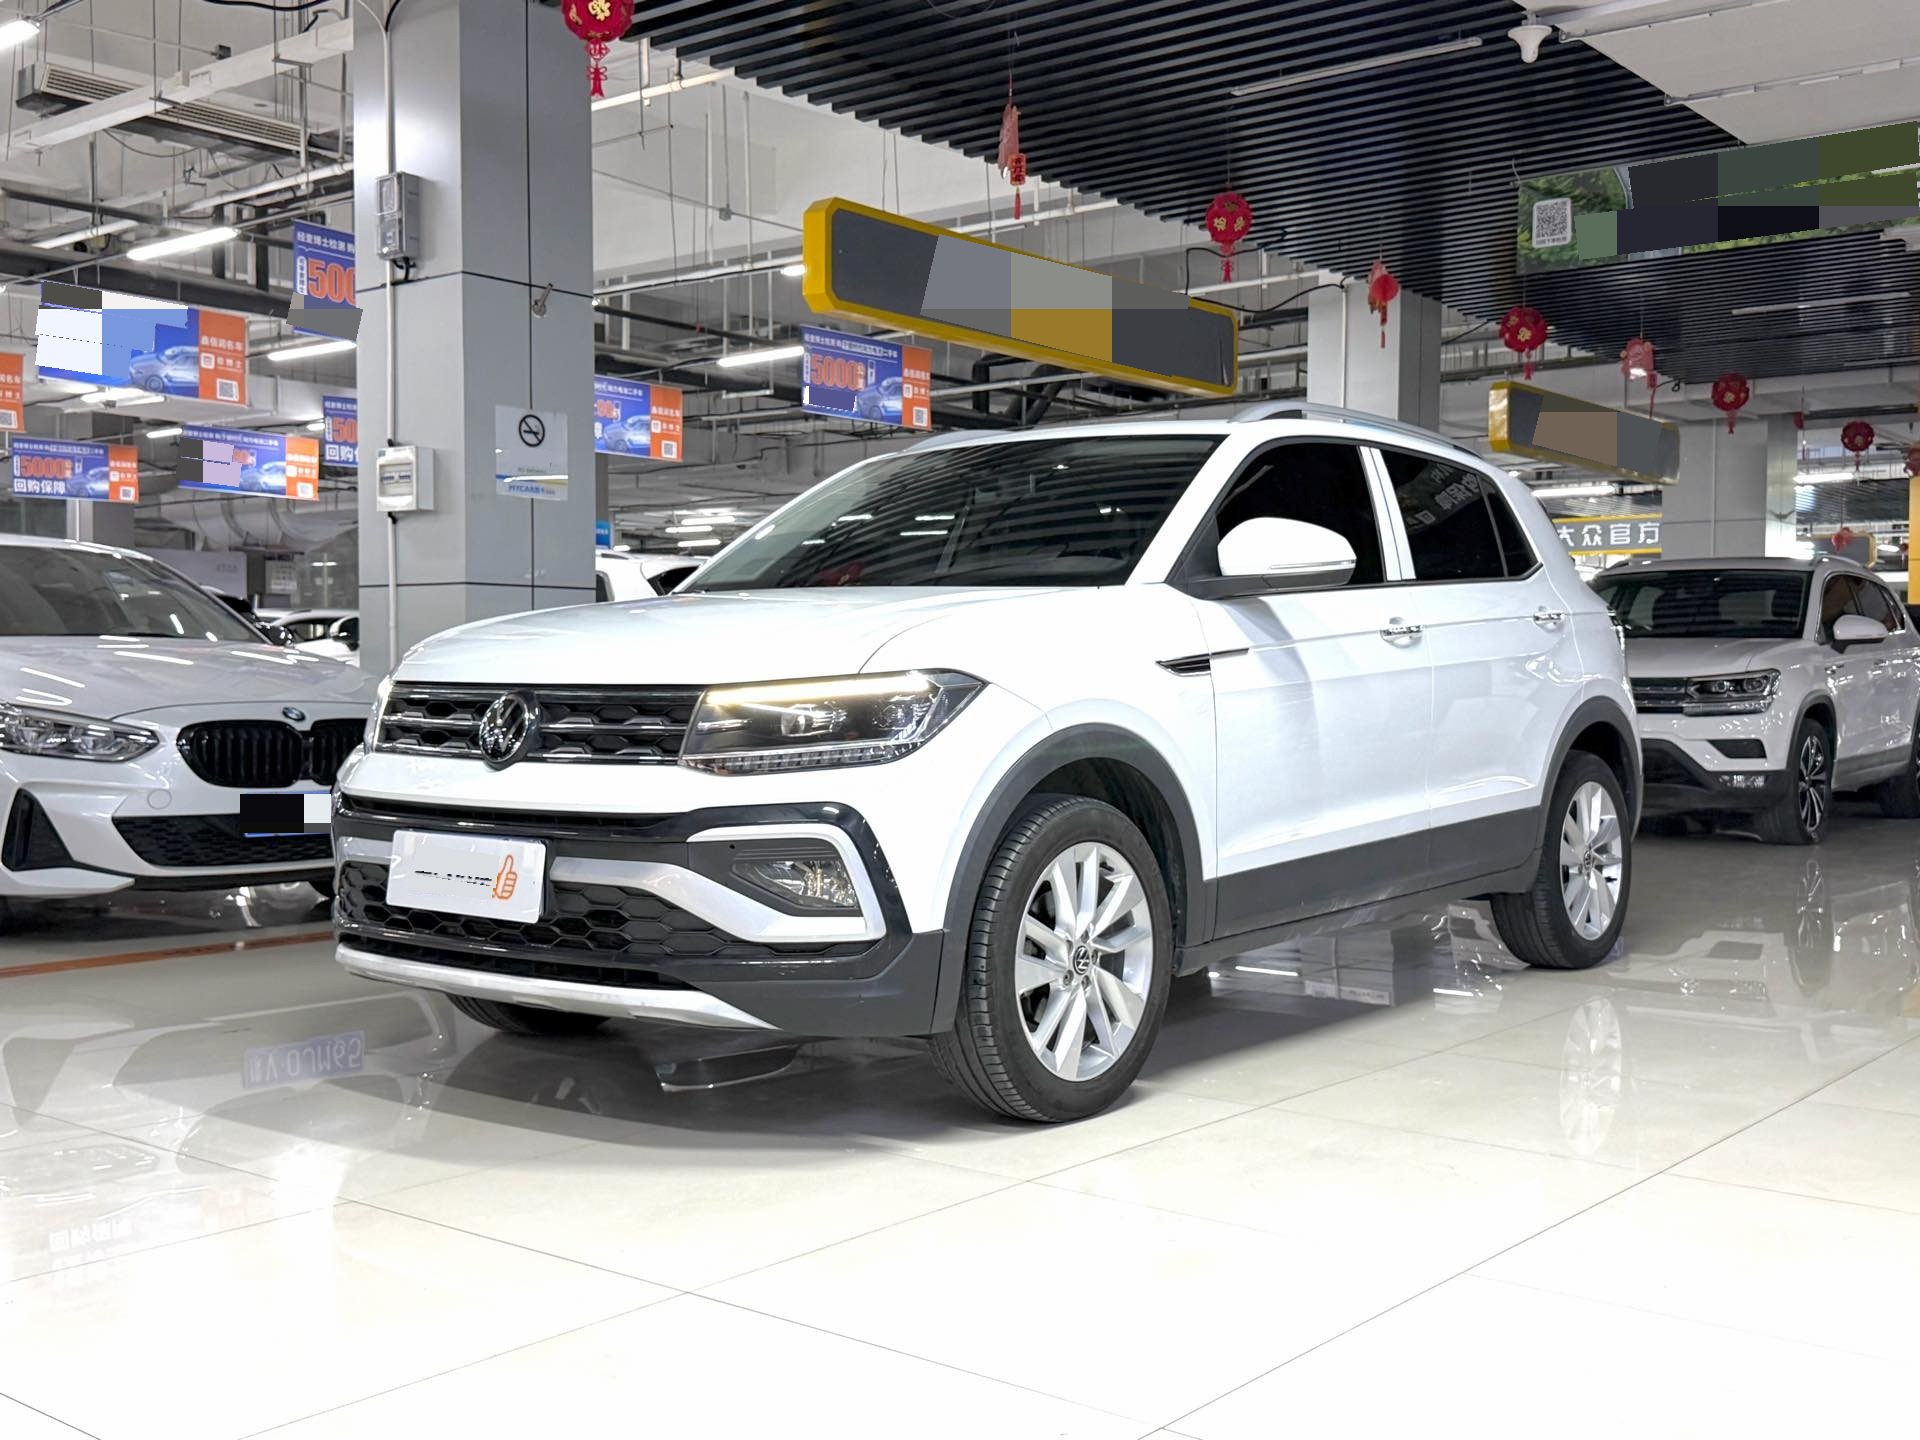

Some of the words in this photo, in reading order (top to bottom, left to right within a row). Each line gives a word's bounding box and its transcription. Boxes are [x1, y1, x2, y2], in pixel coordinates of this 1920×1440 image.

[325, 444, 358, 463] 回购
[14, 478, 66, 496] 回购保障
[1557, 521, 1660, 547] 大众官方
